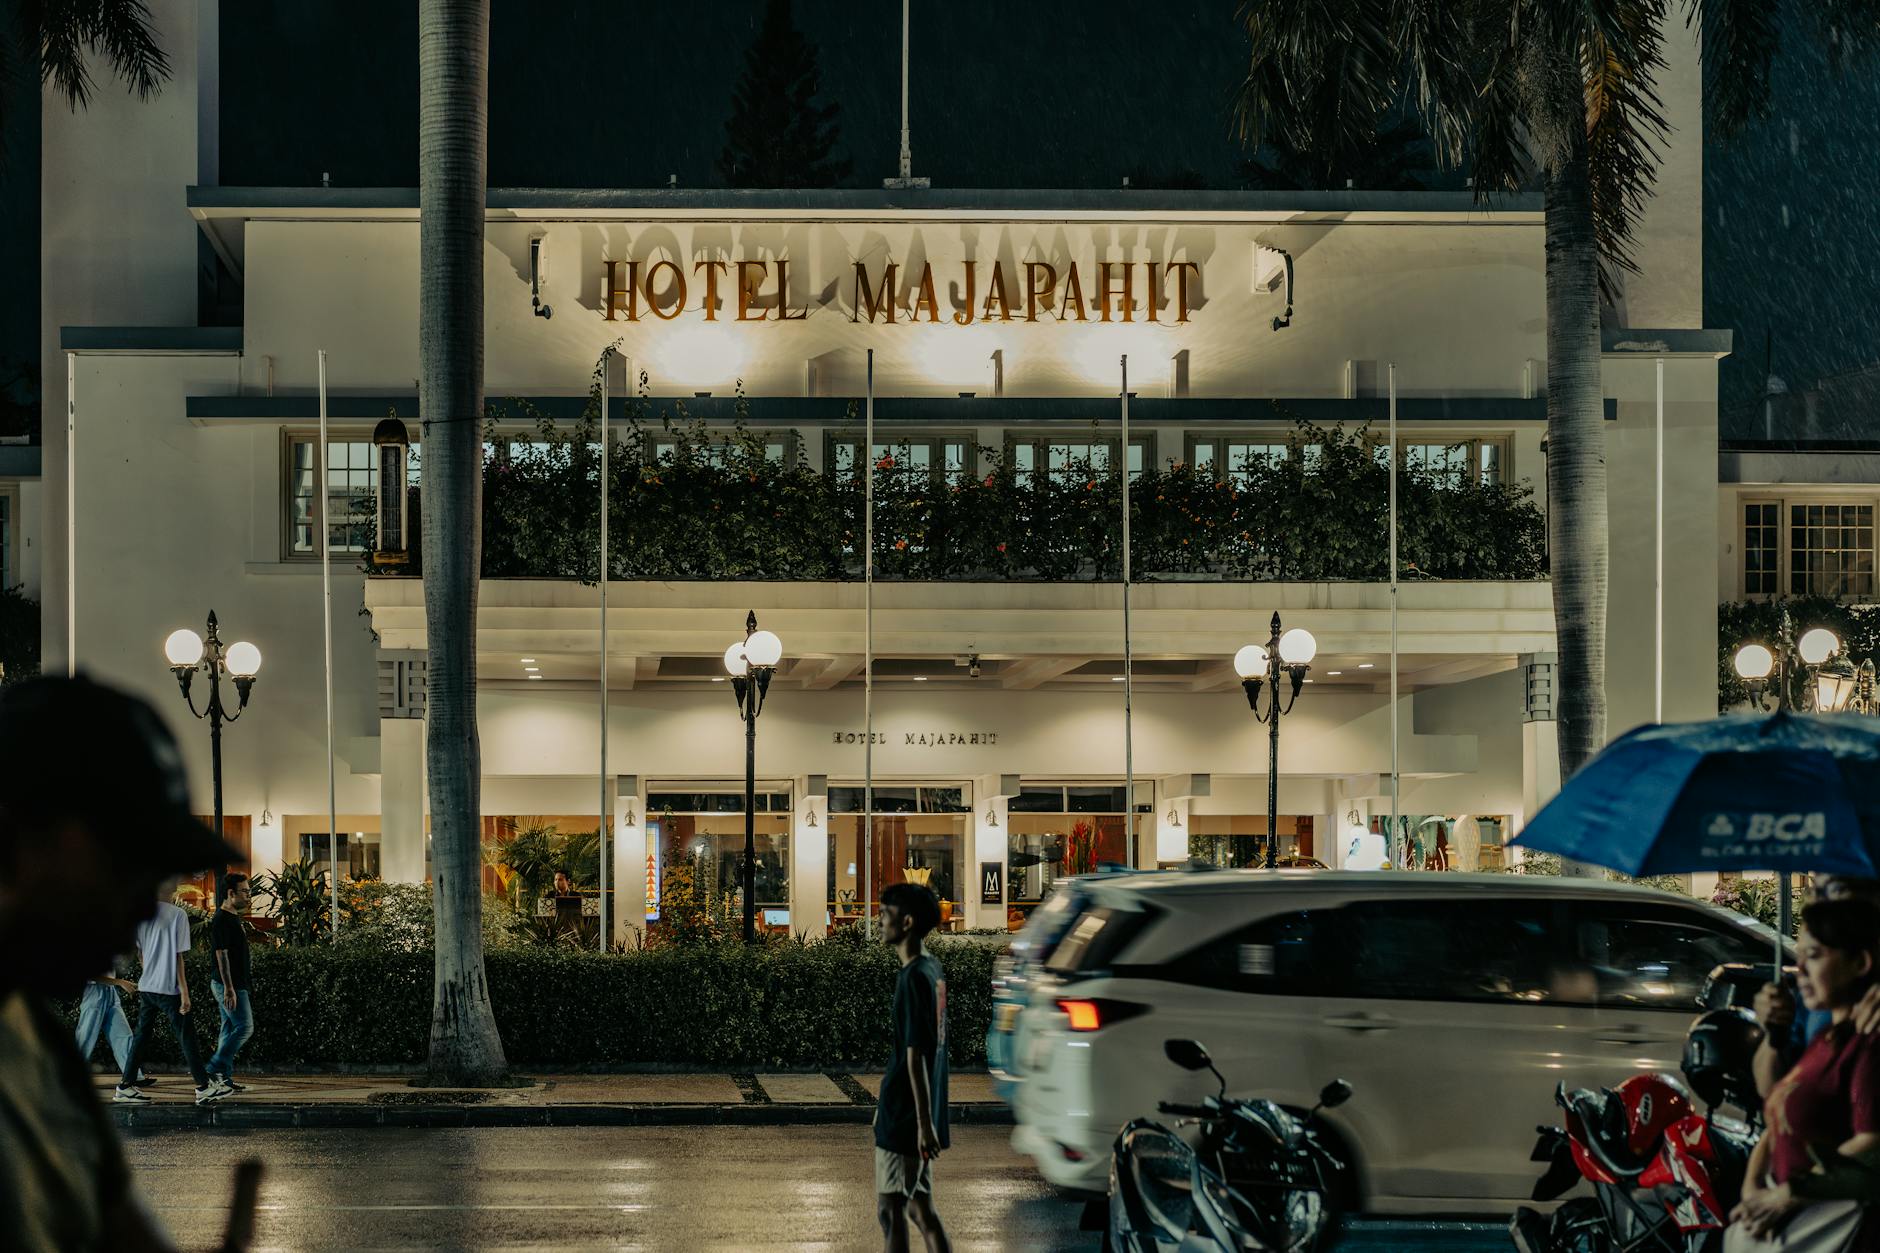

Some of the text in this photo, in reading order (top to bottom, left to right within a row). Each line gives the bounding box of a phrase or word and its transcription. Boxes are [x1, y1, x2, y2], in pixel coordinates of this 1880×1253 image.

[602, 260, 1200, 326] HOTEL MAJAPAHIT
[832, 732, 998, 748] HOTEL MAJAPAHIT
[1746, 812, 1826, 841] BCA
